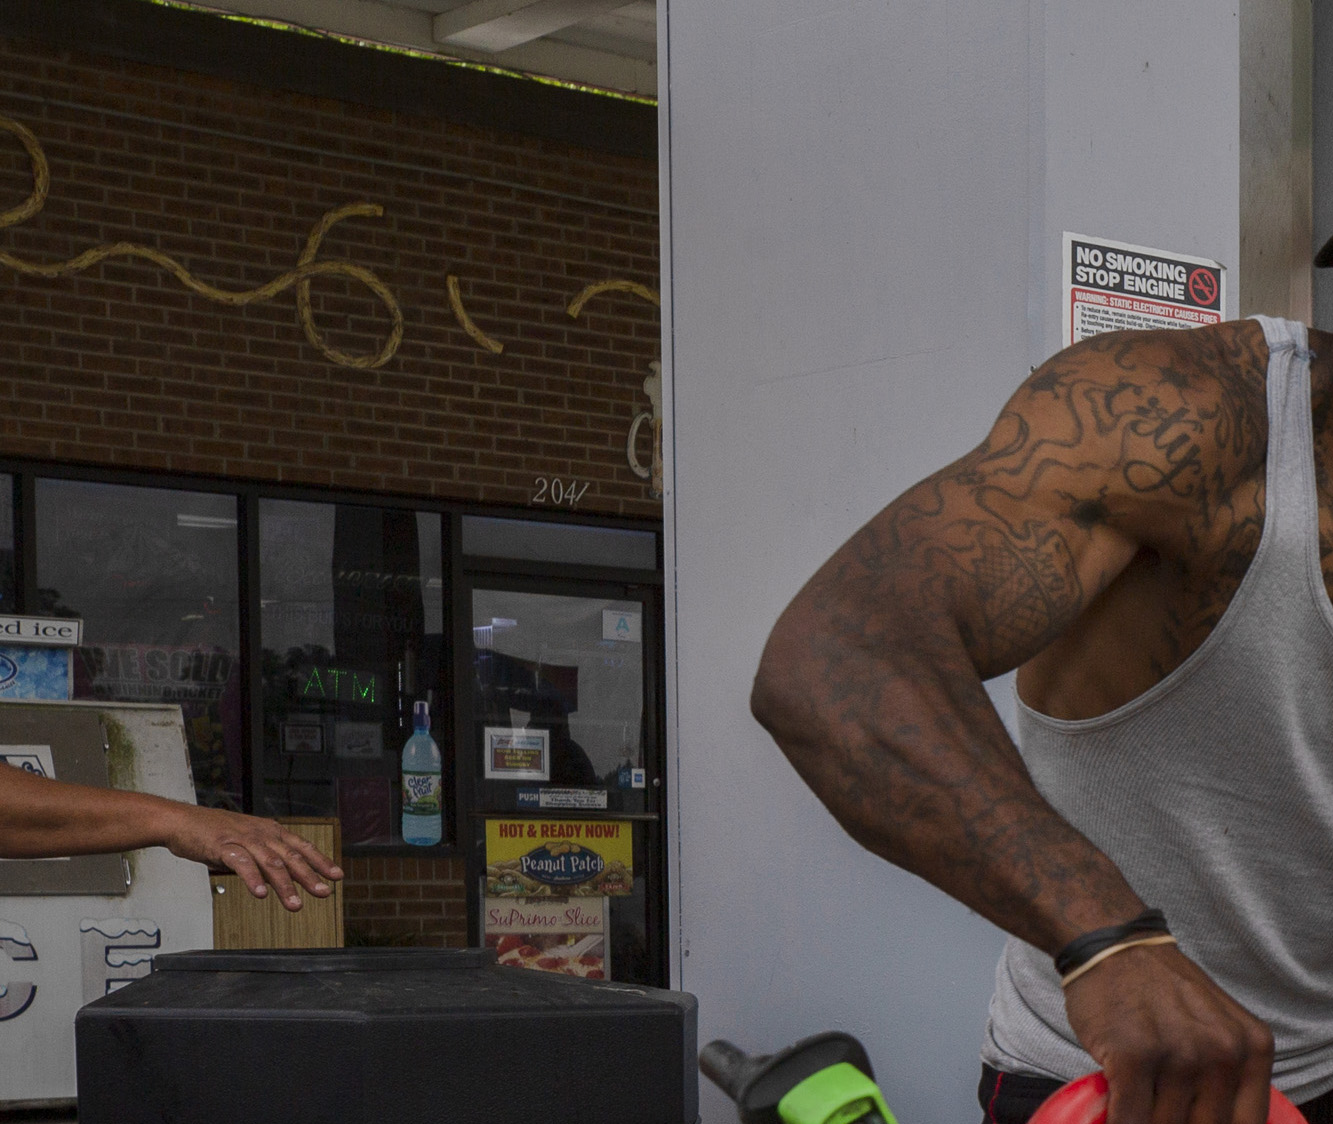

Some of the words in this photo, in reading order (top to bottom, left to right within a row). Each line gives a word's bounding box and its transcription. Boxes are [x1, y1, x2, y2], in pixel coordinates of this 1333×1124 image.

[1076, 246, 1103, 267] NO
[1105, 251, 1187, 284] SMOKING
[1075, 266, 1120, 288] STOP
[1123, 275, 1185, 300] ENGINE
[1075, 291, 1108, 306] WARNING:
[1109, 296, 1133, 310] STATIC
[1133, 301, 1174, 317] ELECTRICITY
[1174, 309, 1199, 322] CAUSES
[1199, 313, 1218, 324] FIRES
[1087, 306, 1101, 314] reduce
[34, 622, 73, 638] ice
[304, 667, 375, 703] ATM
[519, 792, 539, 801] PUSH
[499, 824, 524, 838] HOT
[527, 824, 537, 838] &
[540, 824, 582, 838] READY
[585, 824, 620, 838] NOW!
[521, 855, 566, 873] Peanut
[570, 855, 604, 872] Patch
[487, 908, 557, 927] SuPrimo
[563, 906, 600, 926] Slice
